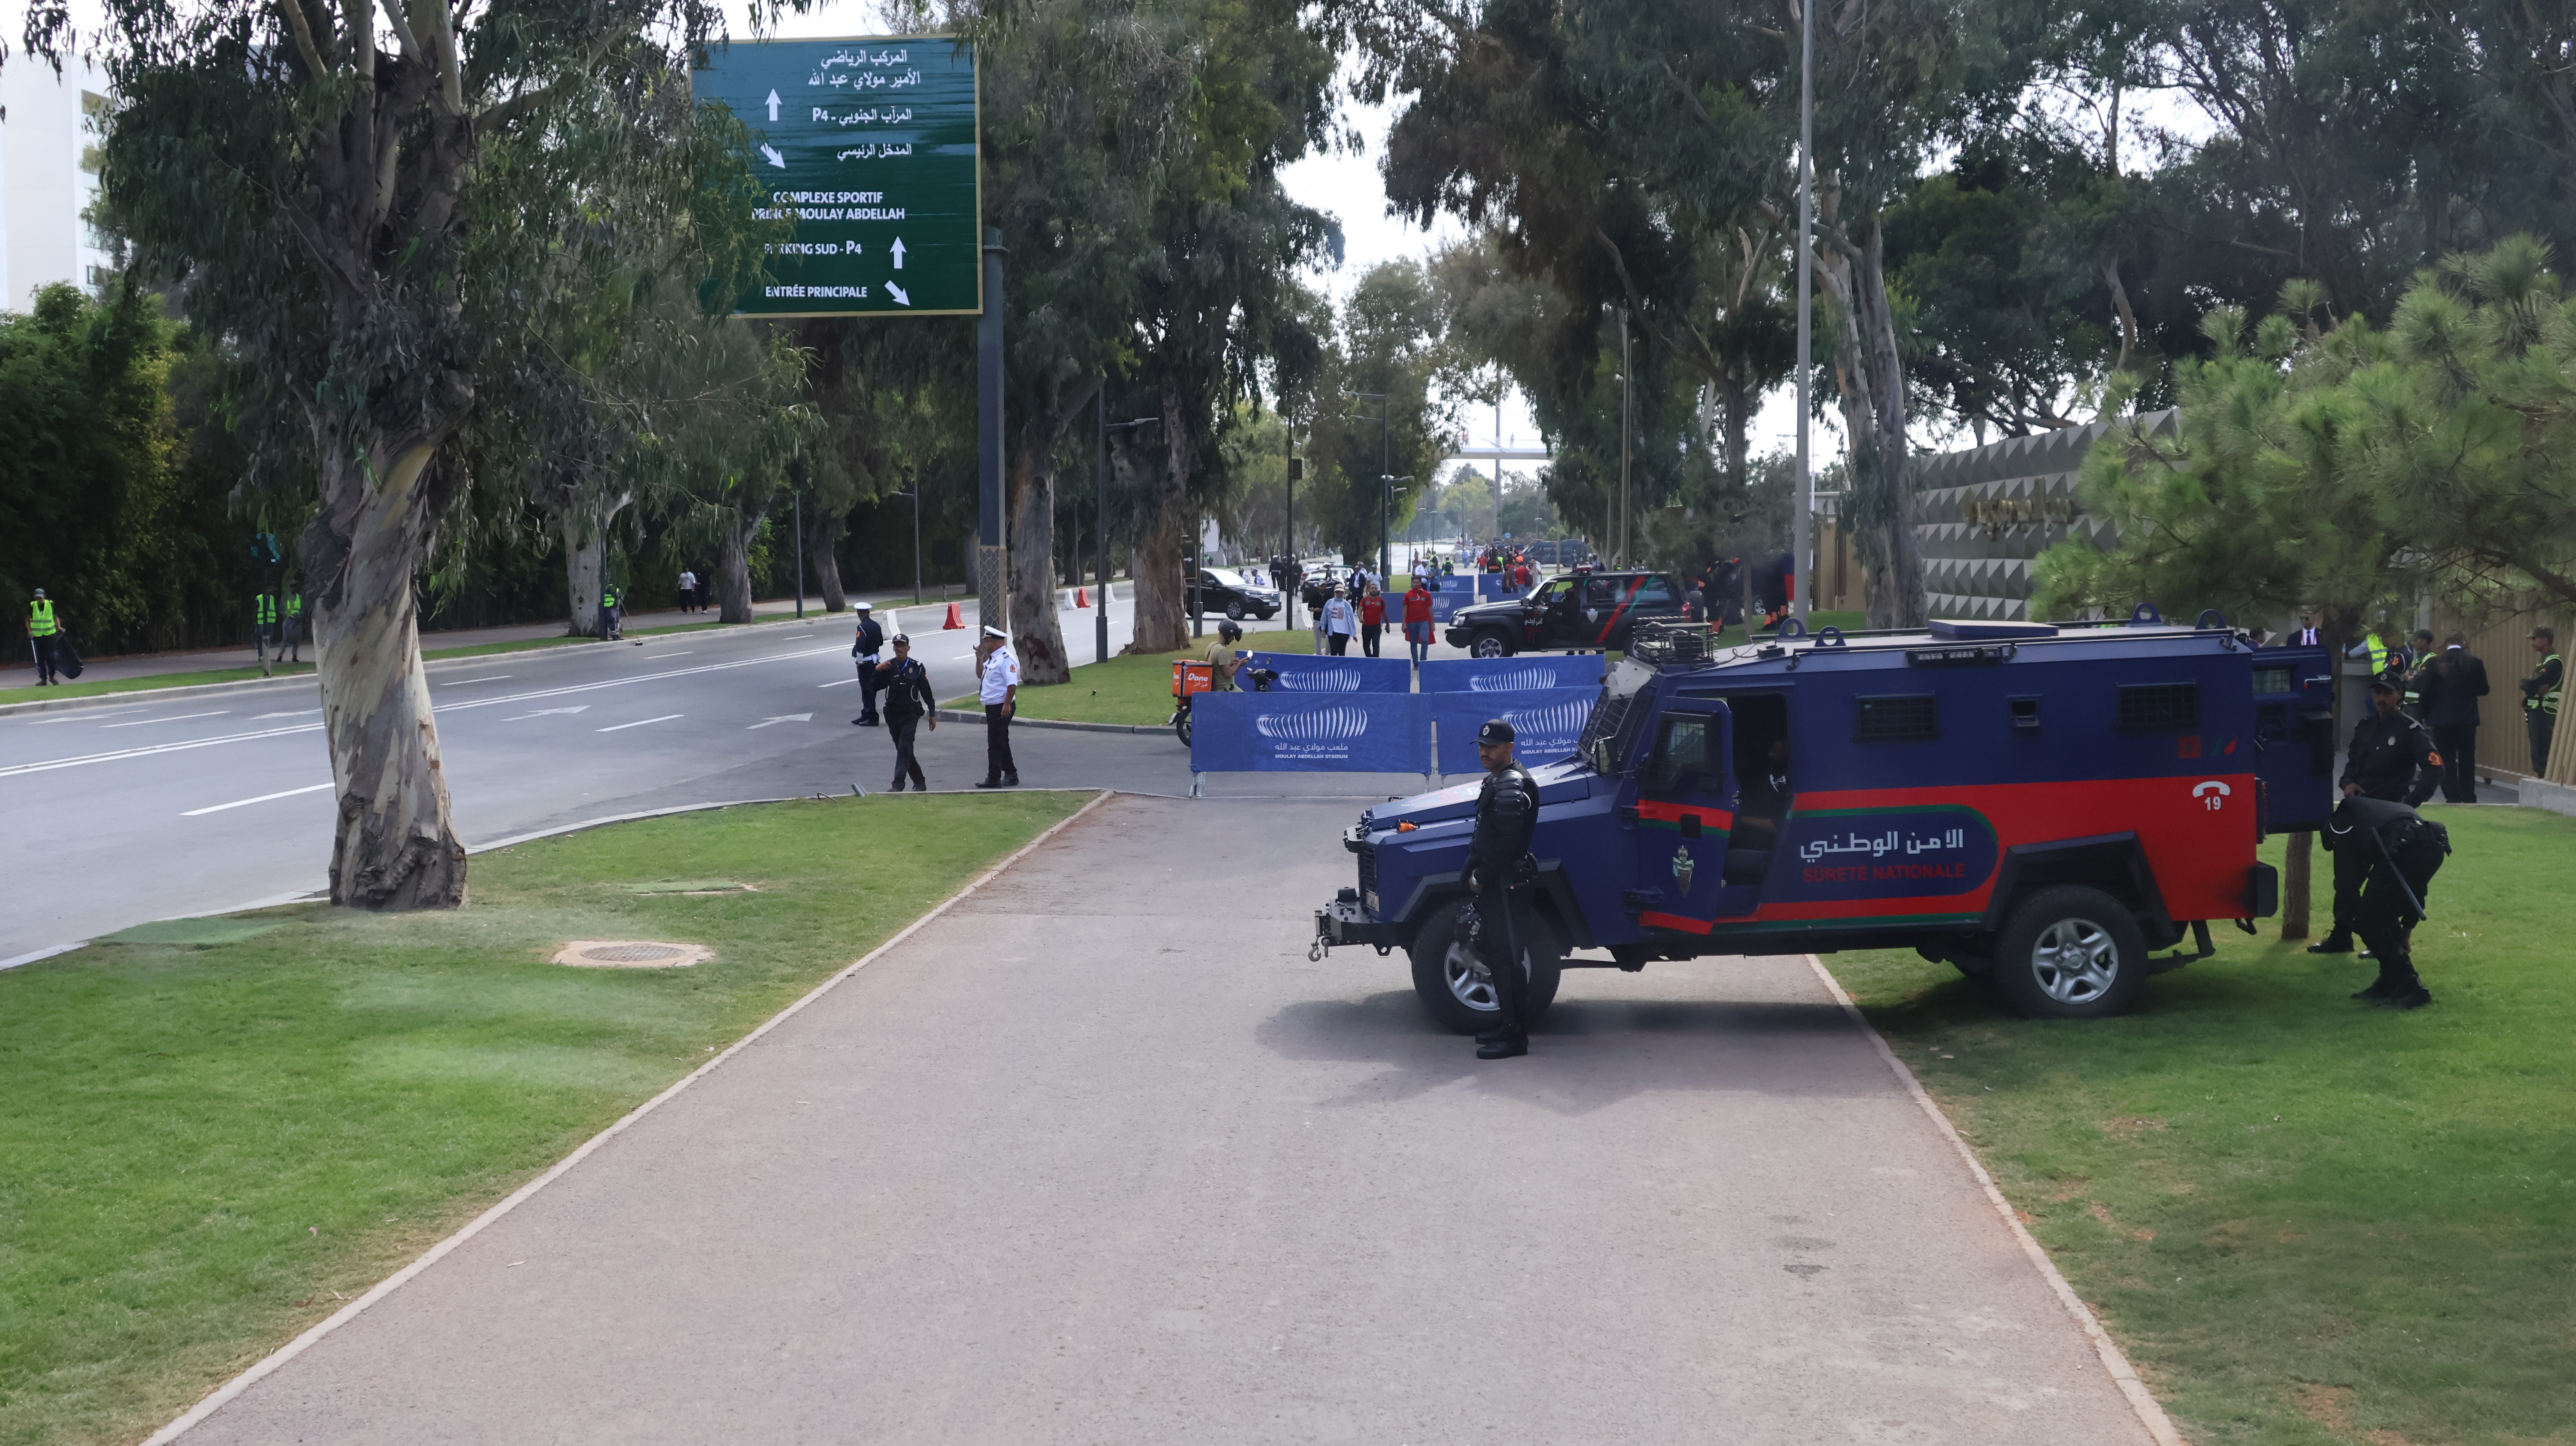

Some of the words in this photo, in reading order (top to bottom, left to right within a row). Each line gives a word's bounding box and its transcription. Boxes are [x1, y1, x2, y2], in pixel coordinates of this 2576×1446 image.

[820, 49, 866, 68] الرياضي
[870, 49, 907, 66] المركب
[808, 68, 824, 85] الله
[829, 73, 848, 88] عبد
[854, 72, 885, 90] مولاي
[889, 67, 920, 87] الأمير
[812, 107, 829, 122] P4
[839, 108, 877, 126] الجنوبي
[881, 106, 911, 123] المرآب
[837, 143, 875, 161] الرئيسي
[878, 143, 911, 158] المدخل
[773, 191, 835, 203] COMPLEXE
[837, 191, 883, 203] SPORTIF
[795, 208, 844, 219] MOULAY
[846, 208, 905, 219] ABDELLAH
[815, 243, 837, 254] SUD
[846, 240, 862, 254] P4
[766, 284, 805, 297] ENTRÉE
[808, 286, 867, 297] PRINCIPALE
[1188, 673, 1209, 682] Done
[1303, 743, 1325, 753] مولاي
[1327, 743, 1348, 752] ملعب
[1521, 738, 1533, 746] الله
[1549, 737, 1571, 748] مولاي
[2204, 796, 2221, 811] 19
[1800, 831, 1898, 863] الوطني
[1907, 829, 1963, 854] الأمن
[1803, 863, 1868, 883] SÛRETÉ
[1873, 863, 1965, 880] NATIONALE
